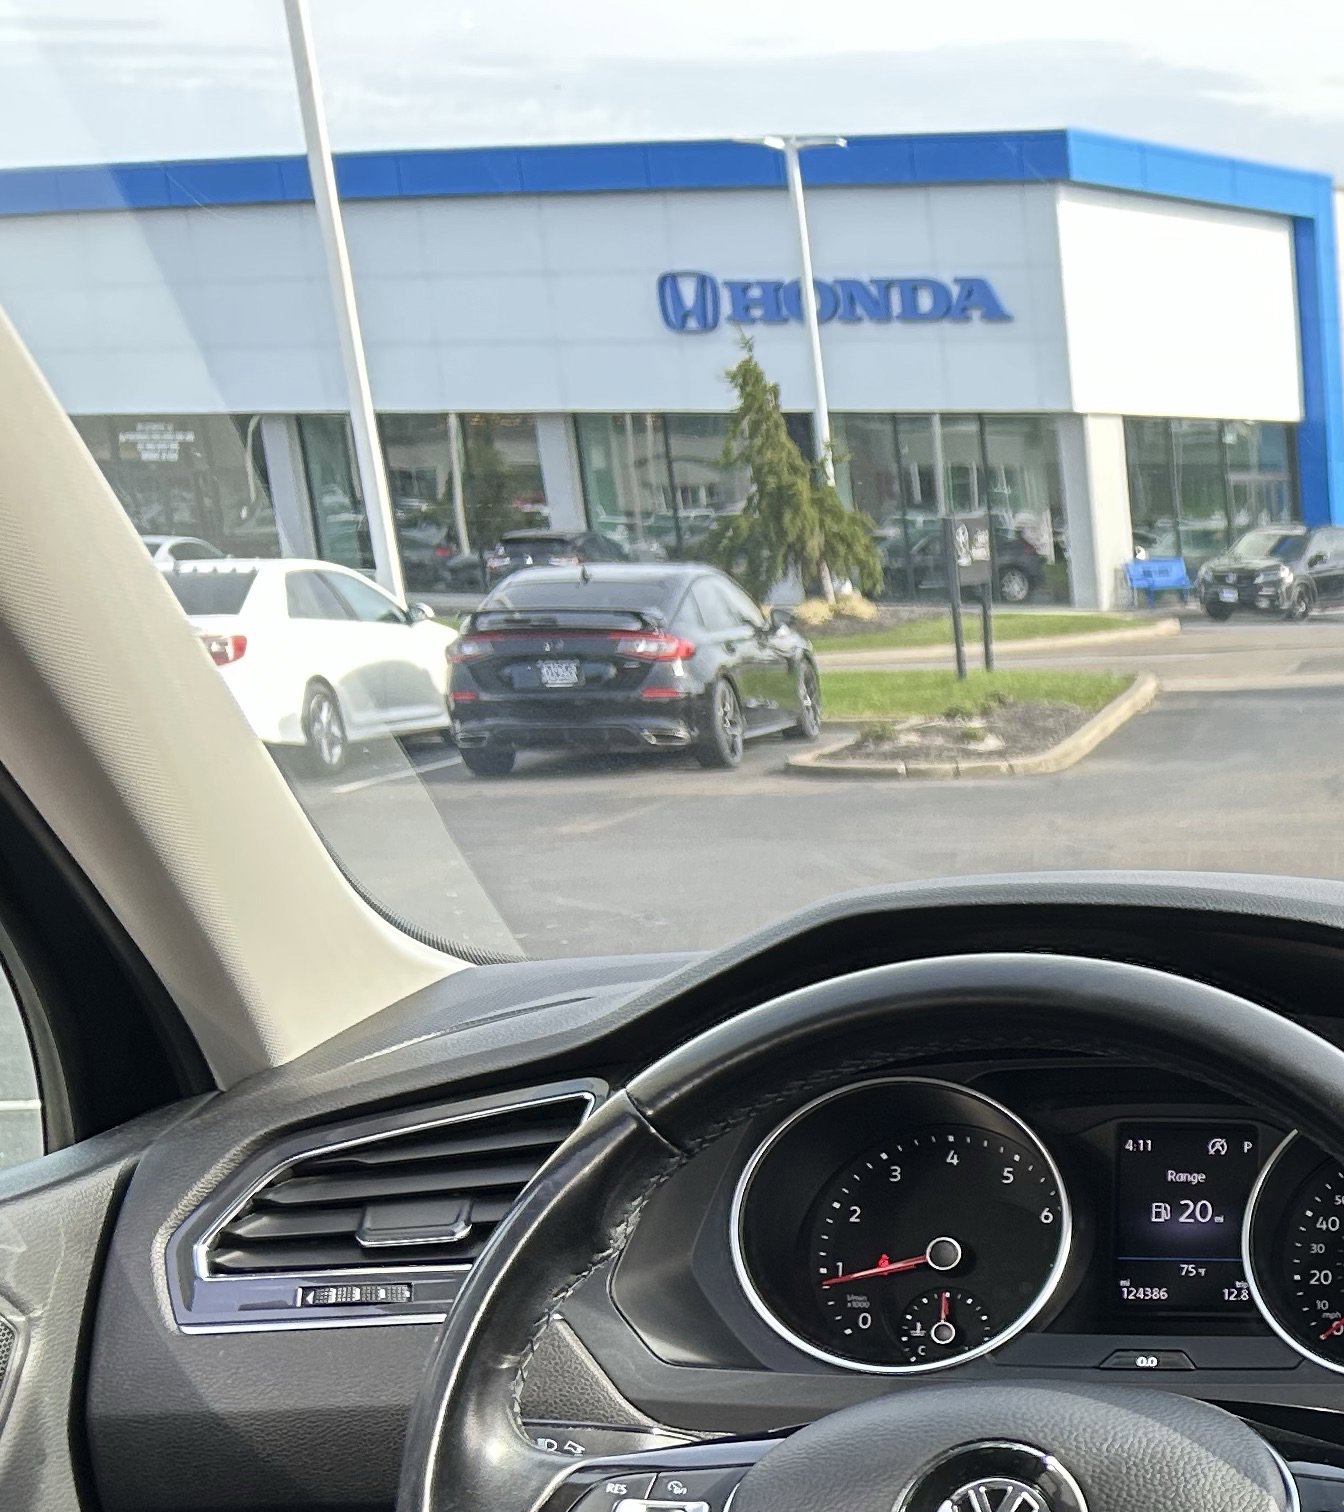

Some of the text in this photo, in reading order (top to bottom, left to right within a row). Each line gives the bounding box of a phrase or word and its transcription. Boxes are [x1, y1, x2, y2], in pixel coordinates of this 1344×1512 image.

[722, 276, 1014, 324] HONDA
[1124, 1139, 1152, 1152] 4:11
[1243, 1141, 1253, 1153] P
[946, 1150, 960, 1166] 4
[889, 1165, 901, 1182] 3
[1001, 1167, 1014, 1184] 5
[1167, 1170, 1206, 1185] Range
[849, 1205, 861, 1223] 2
[1040, 1208, 1054, 1224] 6
[1178, 1200, 1213, 1223] 20
[1316, 1216, 1340, 1232] 40
[1310, 1243, 1325, 1254] 30
[835, 1262, 843, 1277] 1
[1309, 1270, 1333, 1285] 20
[1121, 1287, 1169, 1300] 124386
[1222, 1288, 1250, 1301] 12.8
[1316, 1300, 1329, 1311] 10
[858, 1313, 872, 1329] 0
[1322, 1310, 1341, 1320] mph
[918, 1346, 926, 1356] C
[606, 1483, 628, 1495] RES
